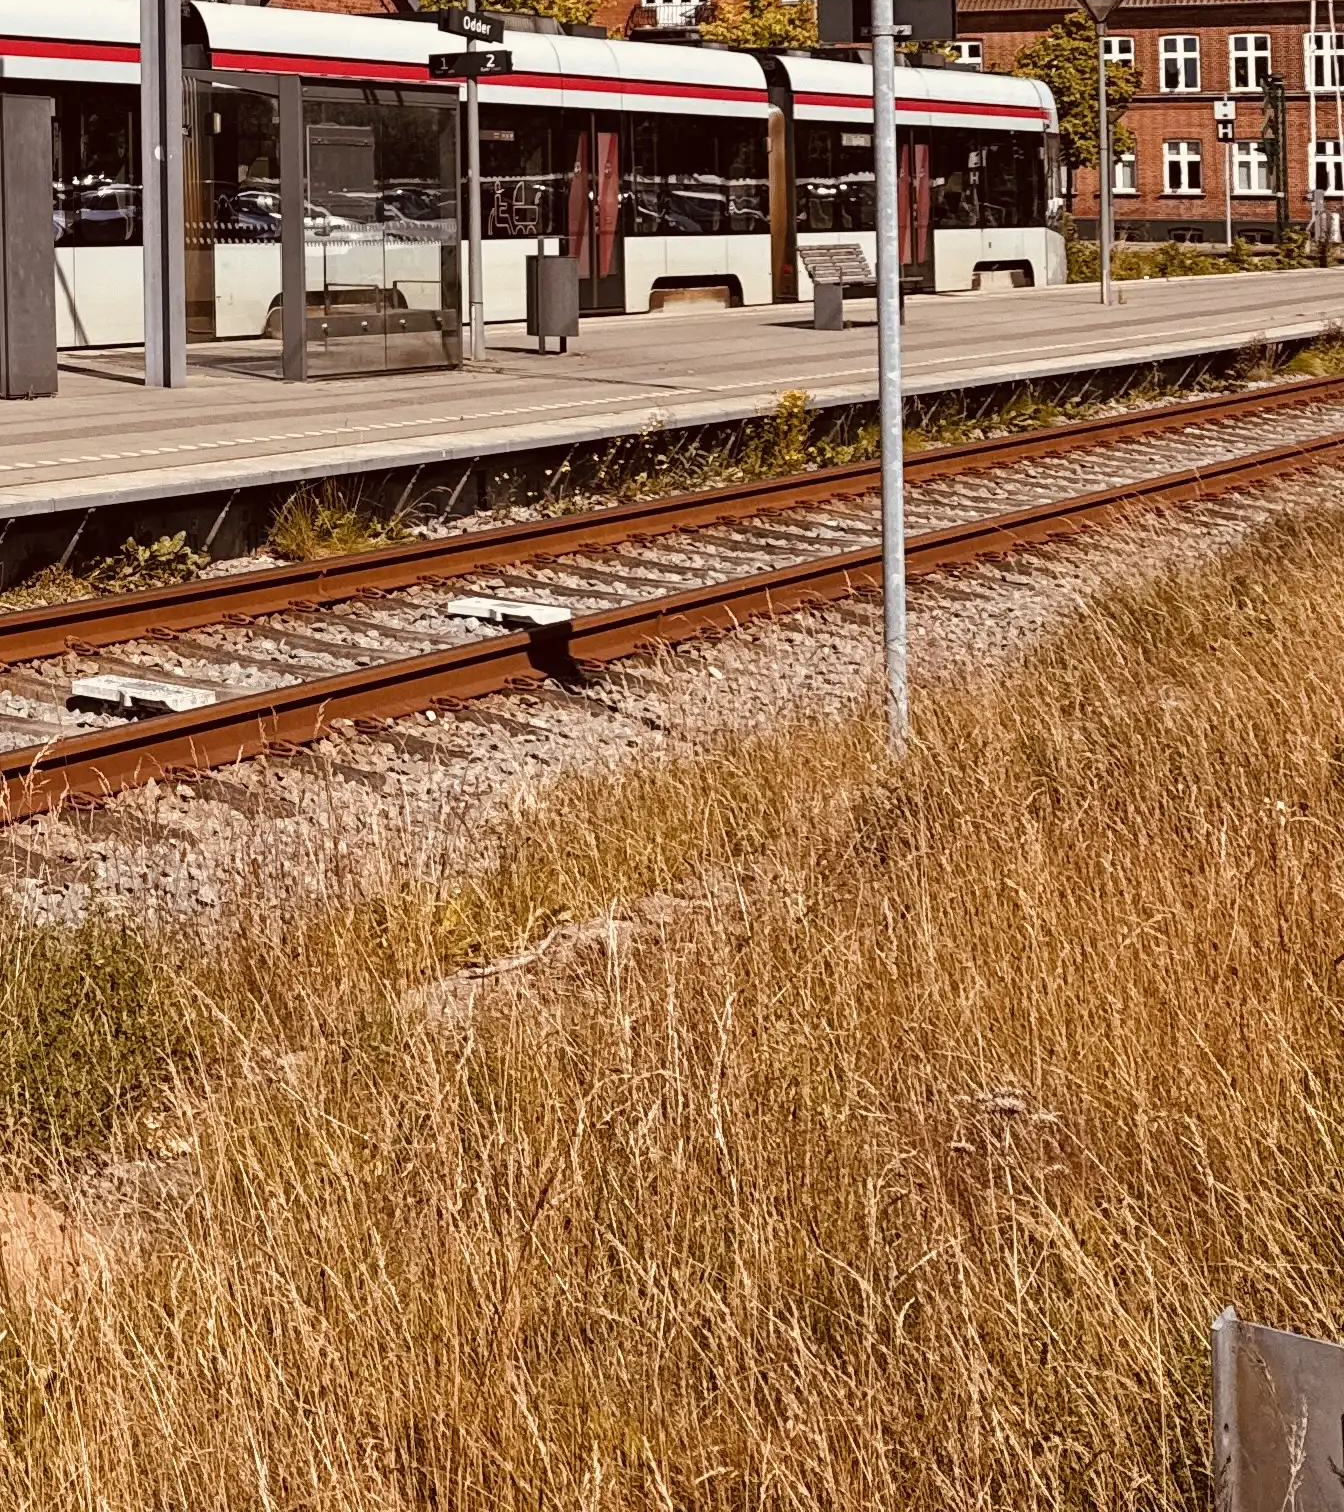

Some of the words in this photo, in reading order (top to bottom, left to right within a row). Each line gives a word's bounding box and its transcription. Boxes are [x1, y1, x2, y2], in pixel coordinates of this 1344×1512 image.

[463, 15, 491, 35] Odder
[440, 57, 449, 69] 1
[485, 54, 496, 68] 2
[1217, 123, 1233, 138] H
